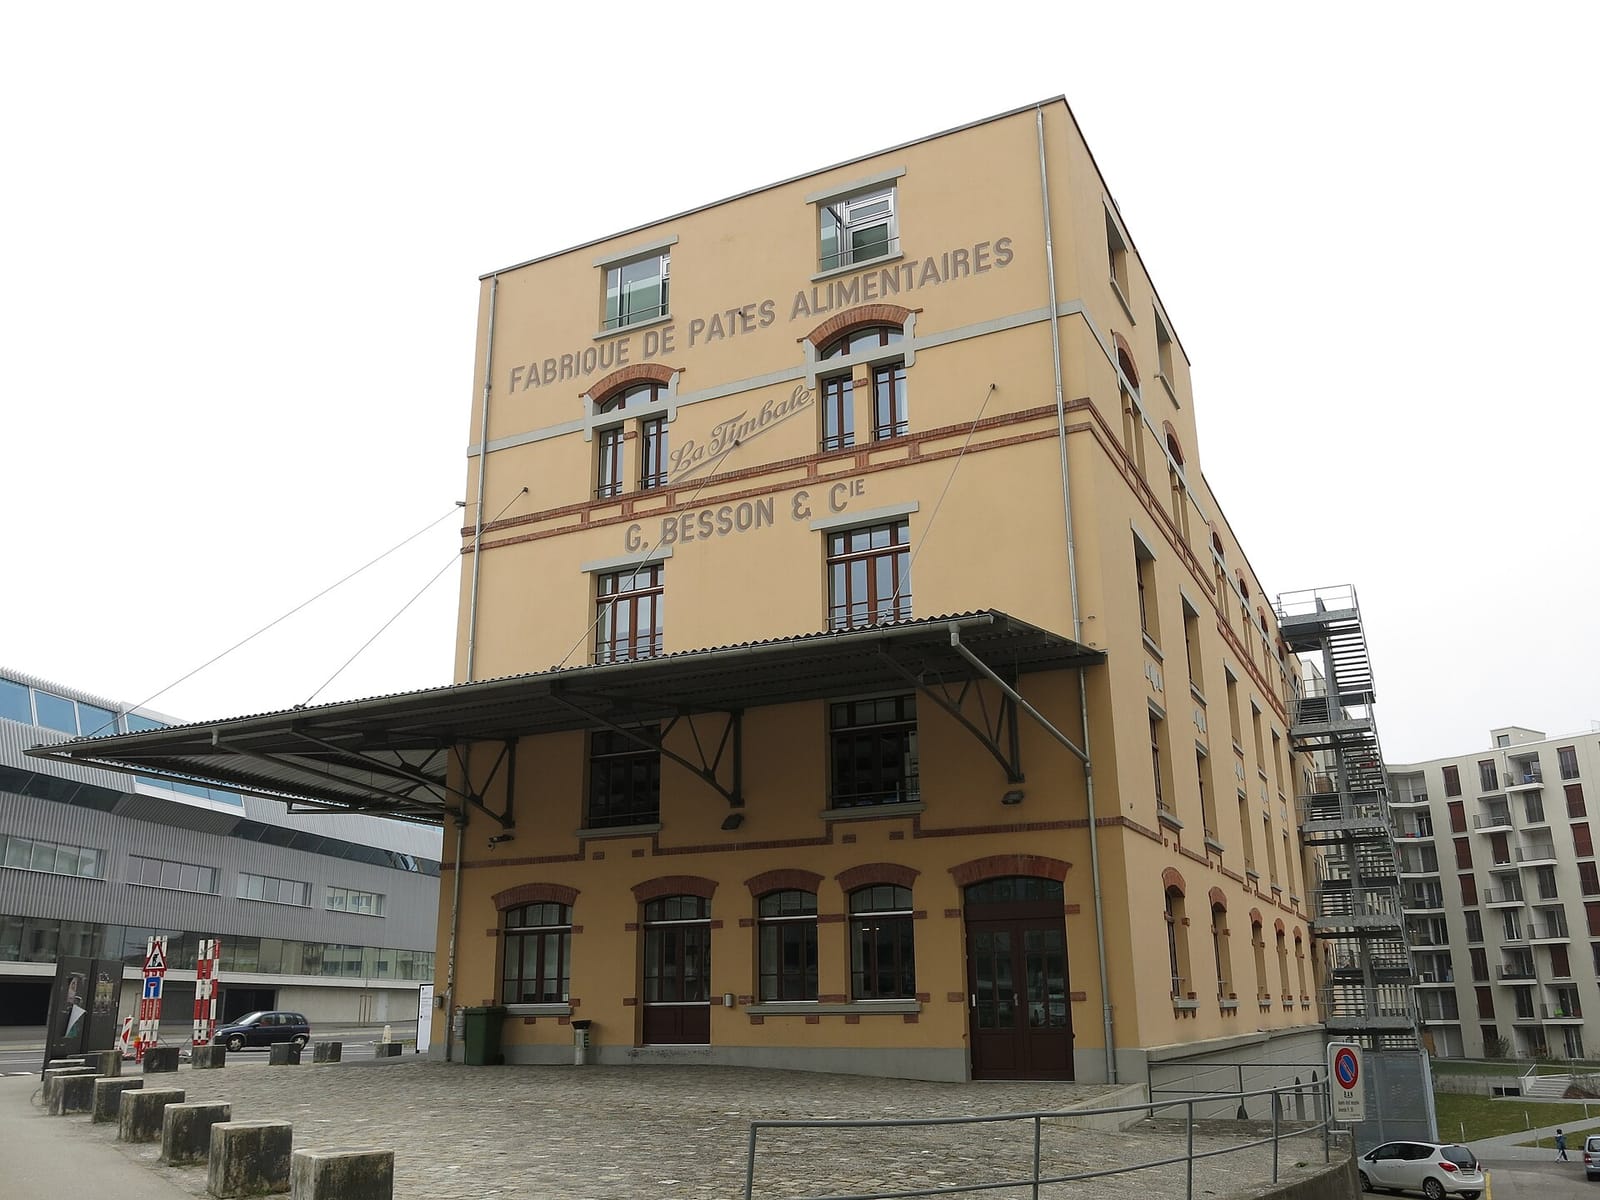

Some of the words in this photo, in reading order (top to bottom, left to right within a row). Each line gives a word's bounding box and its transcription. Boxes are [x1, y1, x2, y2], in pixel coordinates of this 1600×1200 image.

[510, 339, 629, 392] FABRIQUE
[643, 326, 675, 358] DE
[688, 299, 775, 348] PATES
[791, 237, 1014, 319] ALIMENTAIRES
[670, 439, 704, 474] La
[708, 384, 813, 457] Timbale
[625, 523, 649, 552] G.
[661, 497, 775, 545] BESSON
[791, 490, 812, 521] &
